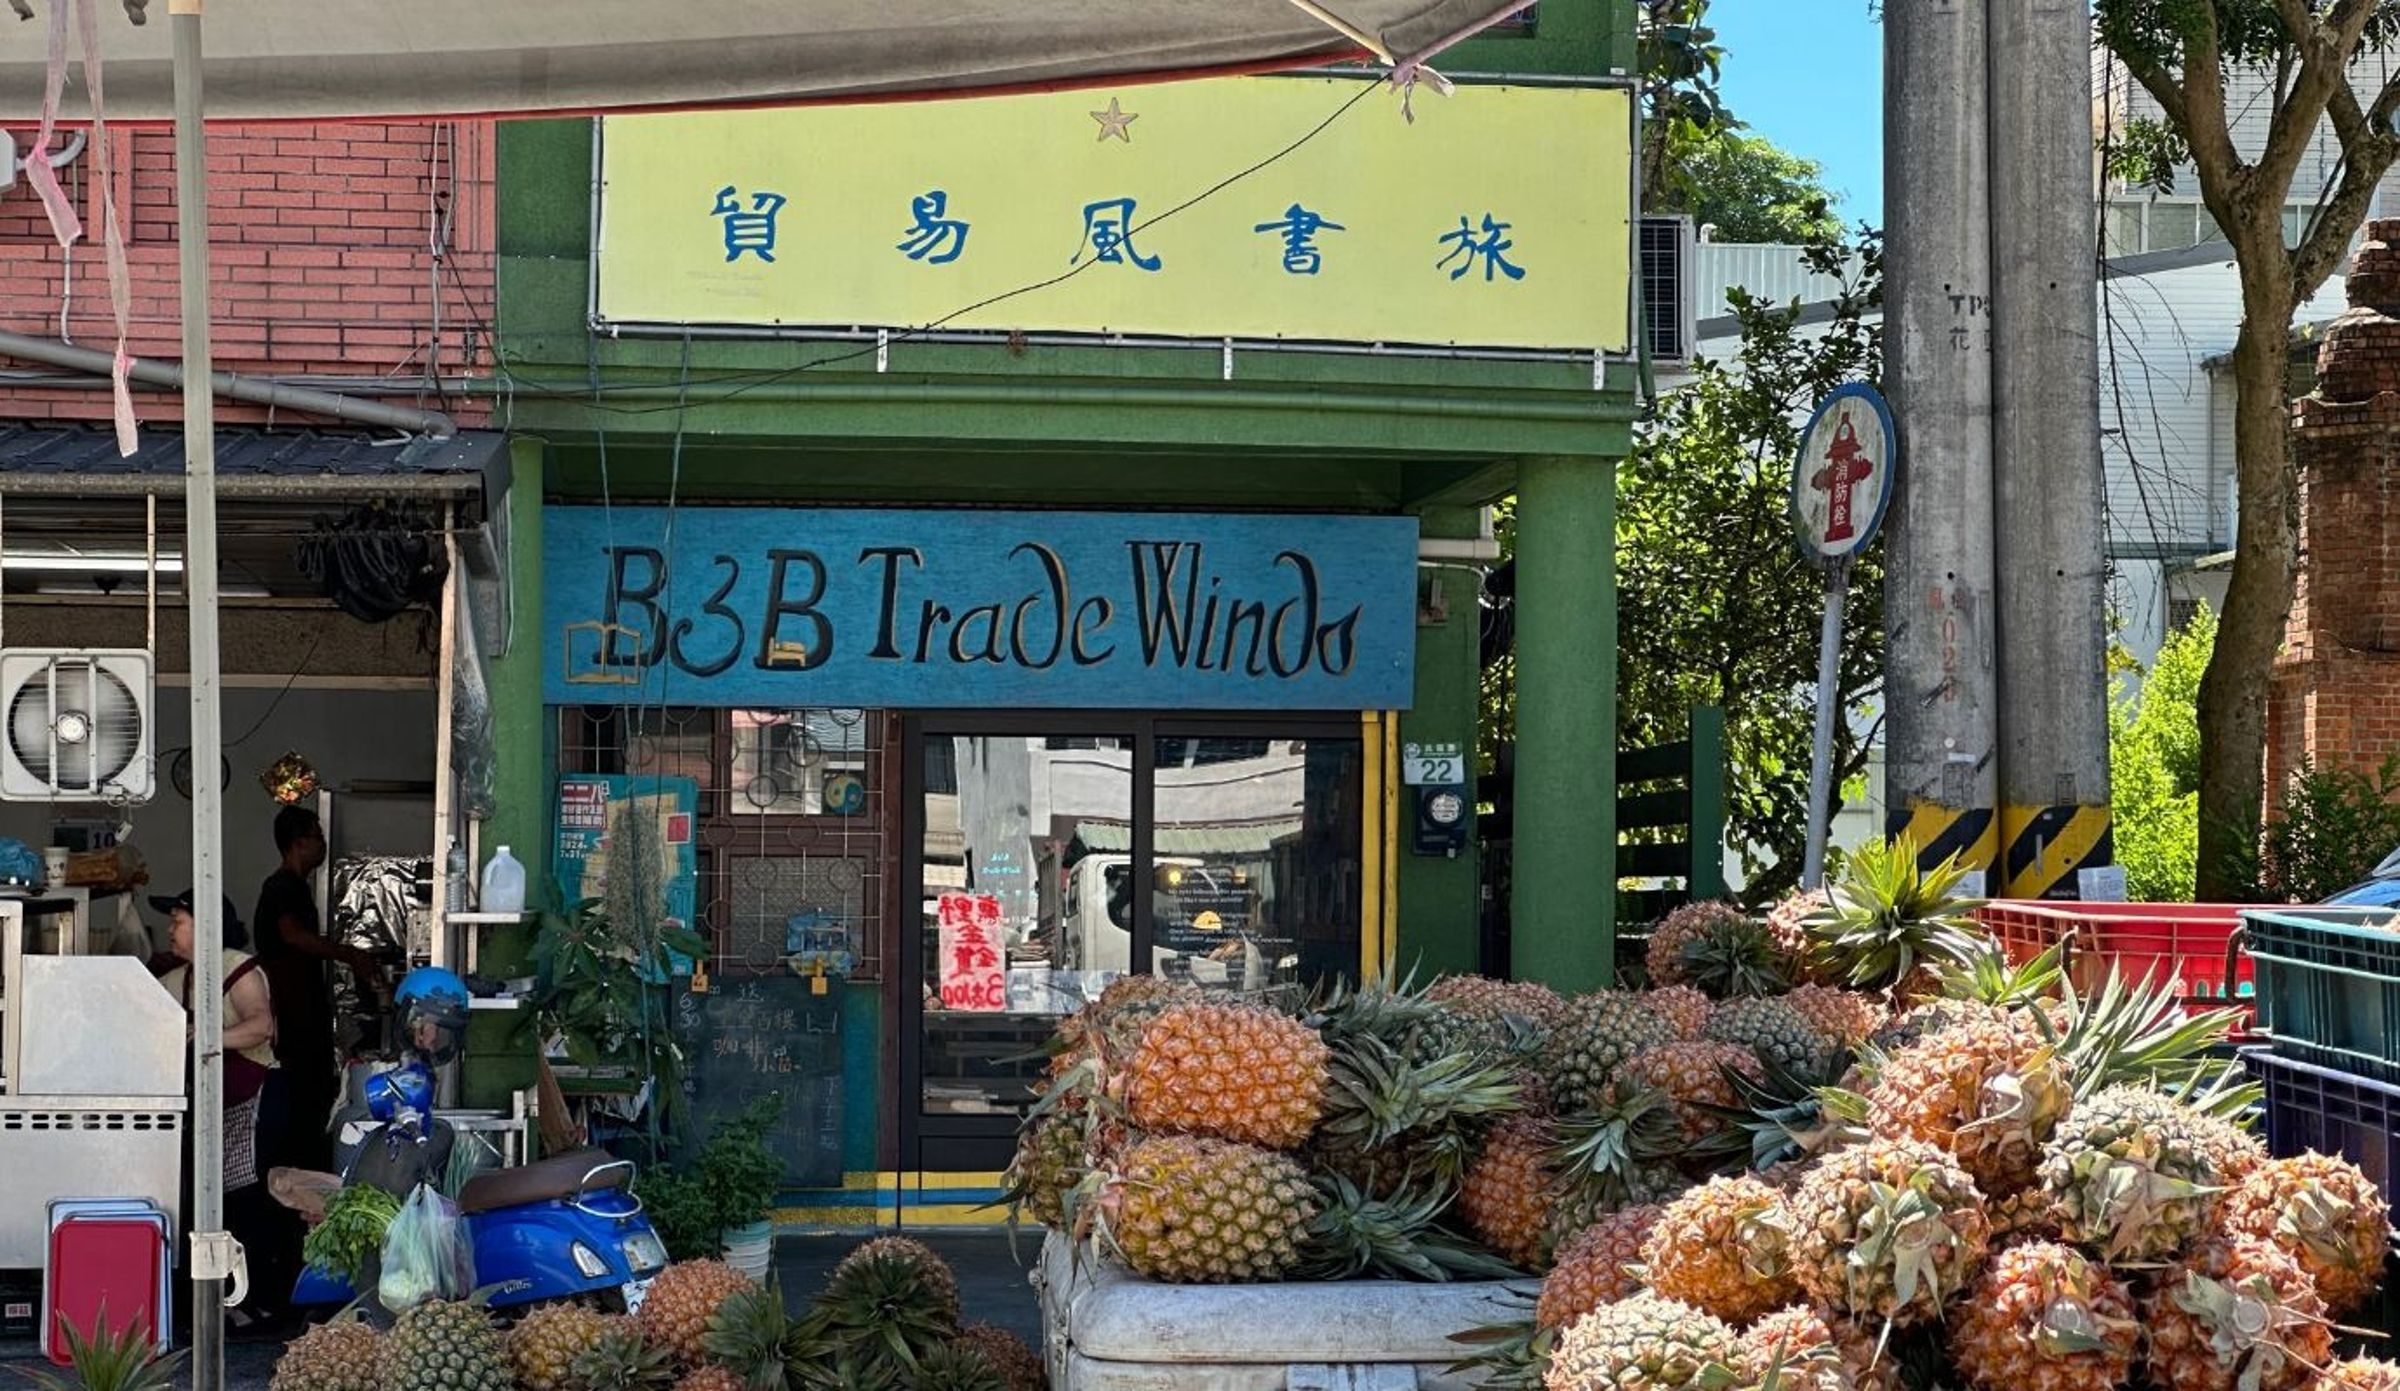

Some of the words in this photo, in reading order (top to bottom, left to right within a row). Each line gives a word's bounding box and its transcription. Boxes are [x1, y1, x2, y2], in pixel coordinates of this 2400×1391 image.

[710, 186, 1526, 281] 貿易風書旅
[1834, 460, 1849, 526] 消防栓
[597, 545, 836, 677] B3B
[858, 541, 1117, 668] Trade
[1421, 759, 1453, 782] 22
